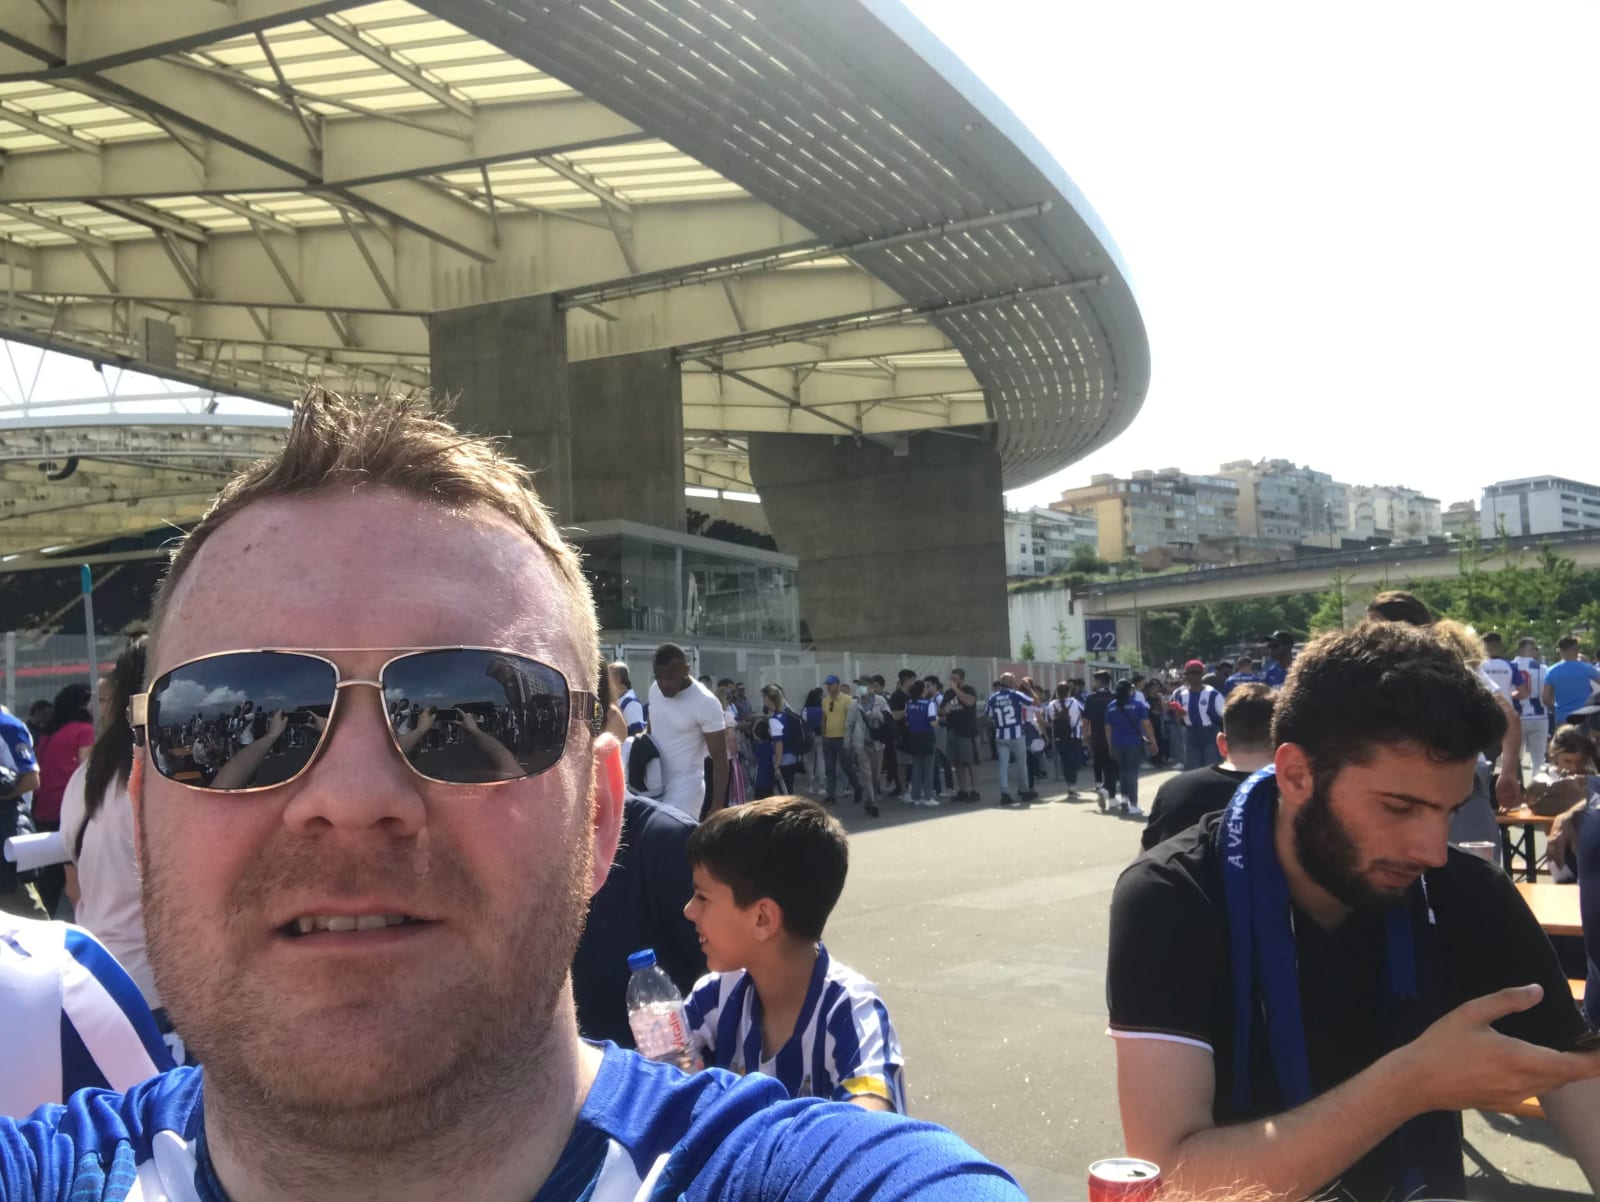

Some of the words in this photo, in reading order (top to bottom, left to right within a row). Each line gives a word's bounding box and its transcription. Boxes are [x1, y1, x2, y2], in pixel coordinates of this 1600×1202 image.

[1091, 632, 1116, 650] 22
[994, 705, 1017, 727] 12
[1227, 855, 1244, 869] A
